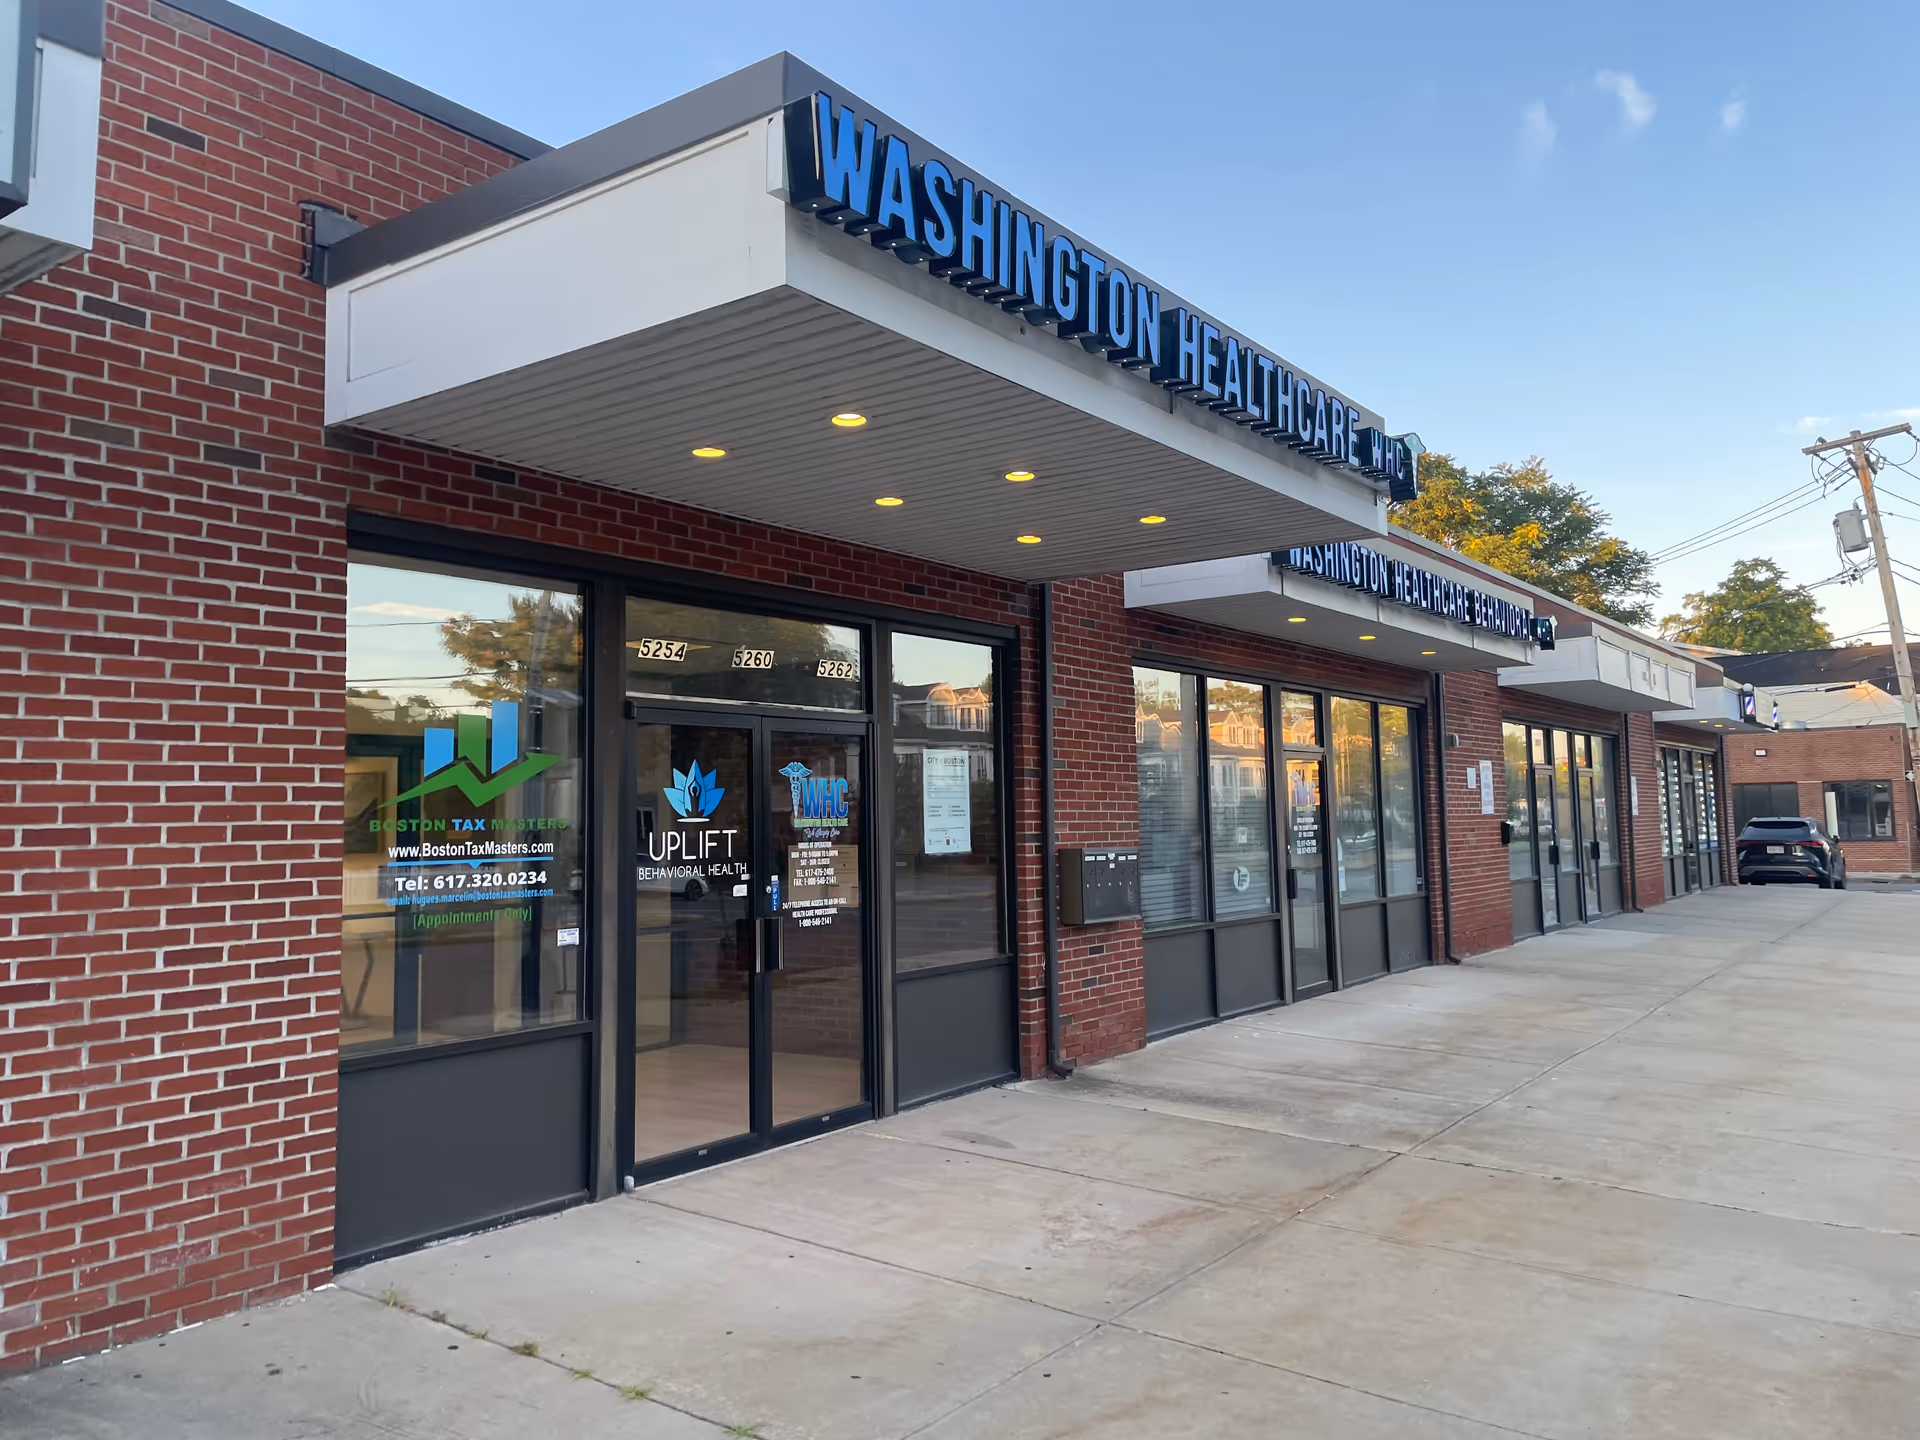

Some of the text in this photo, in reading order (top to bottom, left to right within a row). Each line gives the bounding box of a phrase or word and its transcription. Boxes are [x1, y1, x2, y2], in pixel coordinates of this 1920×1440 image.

[817, 90, 1405, 480] WASHINGTON HEALTHCARE WHC
[1394, 559, 1470, 623] HEALTHCARE
[1474, 590, 1533, 642] BEHAVIORAL
[640, 639, 686, 661] 5254
[733, 650, 772, 667] 5260
[818, 660, 853, 678] 5262
[927, 756, 965, 765] CITY BOSTON
[801, 777, 849, 819] WHC
[369, 817, 568, 833] BOSTON TAX MASTERS
[388, 841, 554, 859] www.BostonTaxMasters.com
[649, 829, 738, 862] UPLIFT
[638, 862, 747, 880] BEHAVIORAL HEALTH
[395, 871, 547, 892] Tel: 617.320.0234
